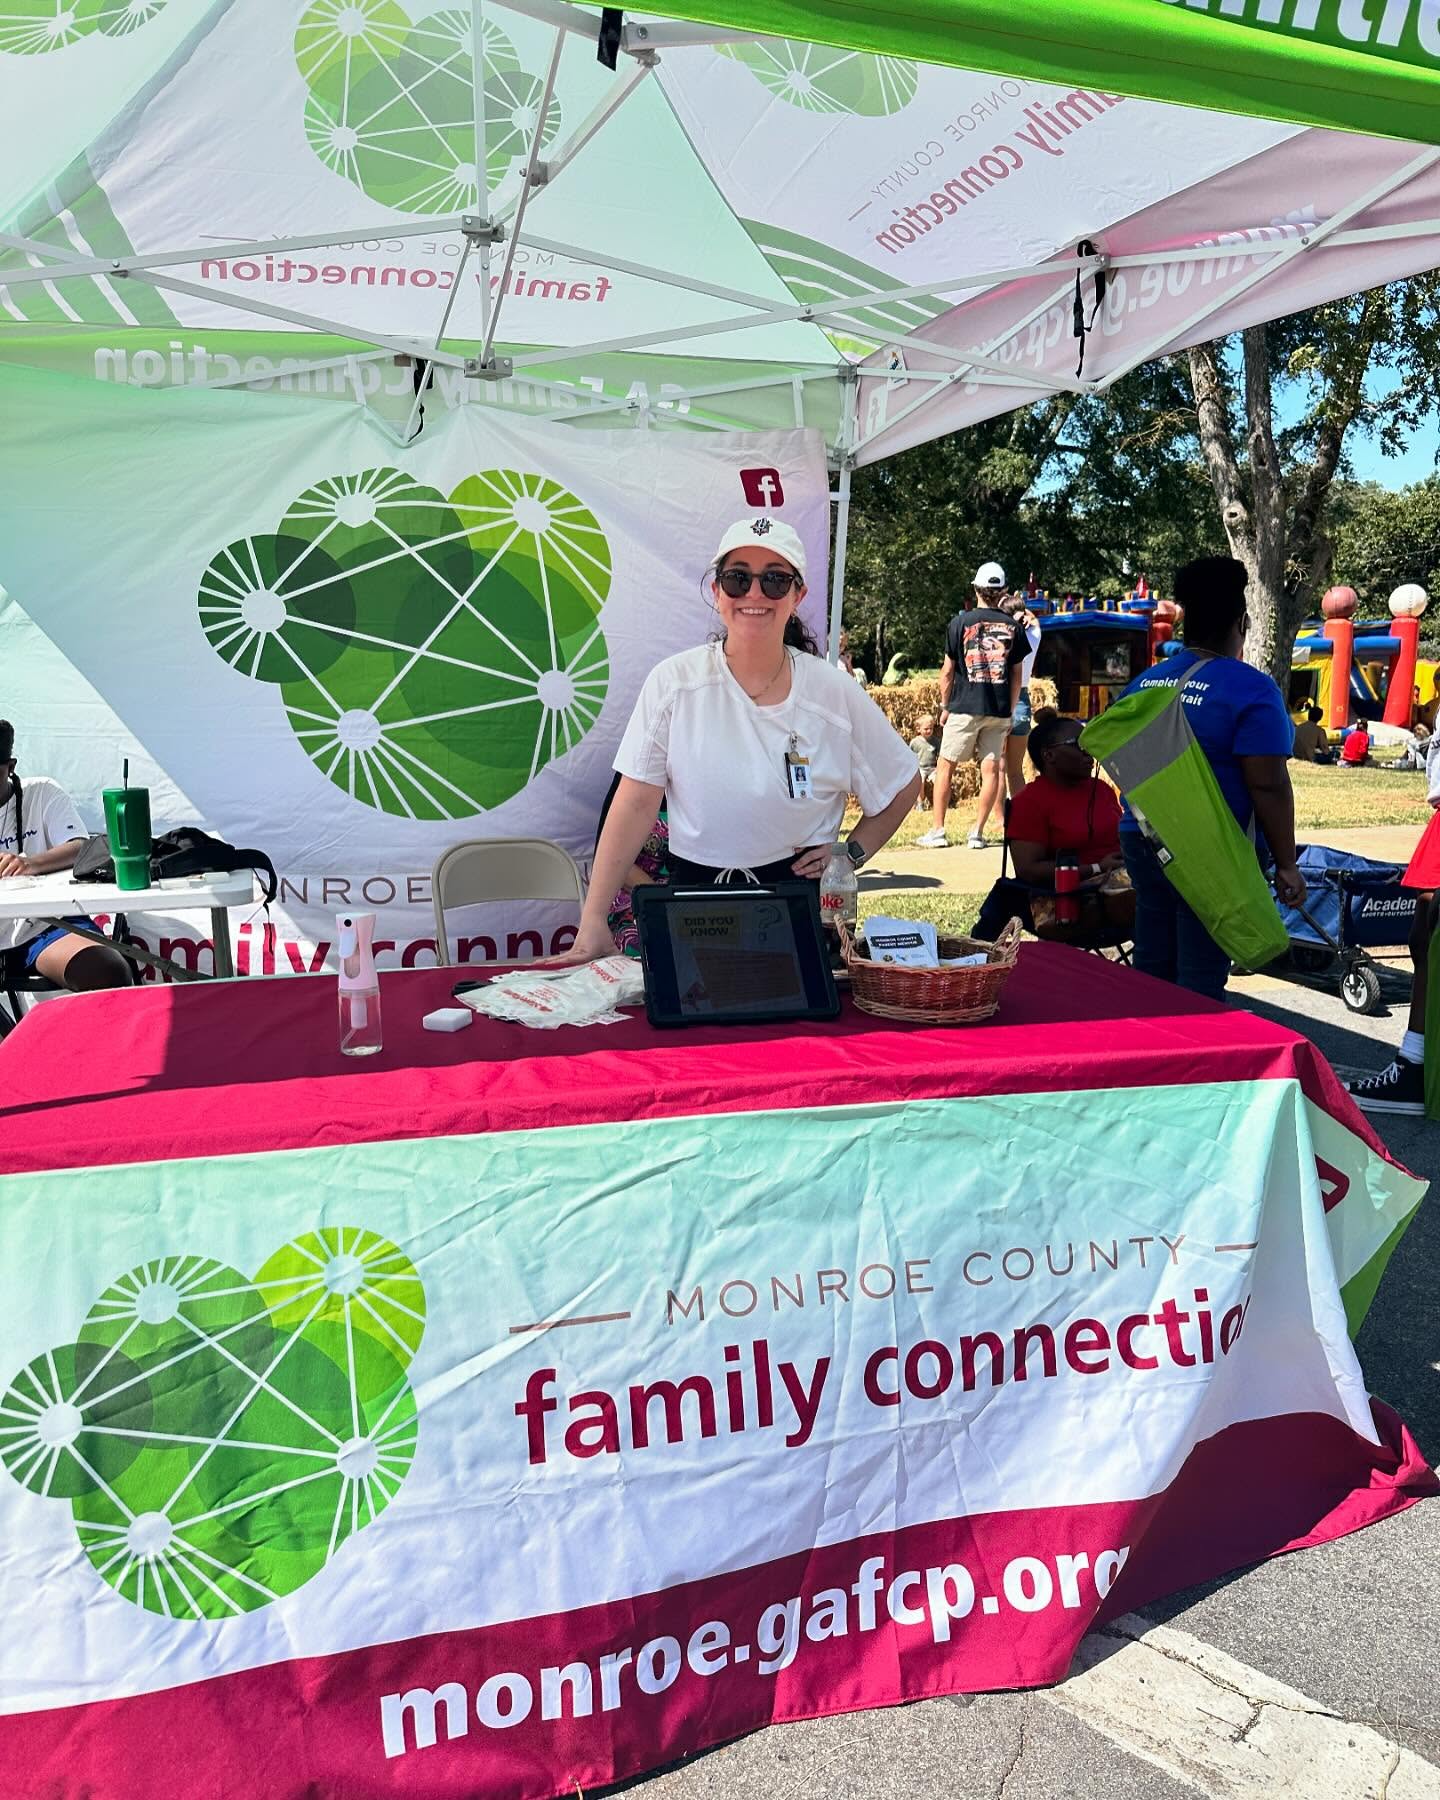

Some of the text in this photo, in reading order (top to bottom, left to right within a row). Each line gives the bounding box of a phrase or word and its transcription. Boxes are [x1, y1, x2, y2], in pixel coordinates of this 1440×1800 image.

[1140, 677, 1178, 688] Complet
[255, 875, 433, 905] NROE
[684, 915, 734, 926] DID YOU
[690, 926, 729, 937] KNOW
[93, 914, 332, 983] amily
[666, 1234, 1186, 1326] MONROE COUNTY
[514, 1288, 1252, 1465] family connectio
